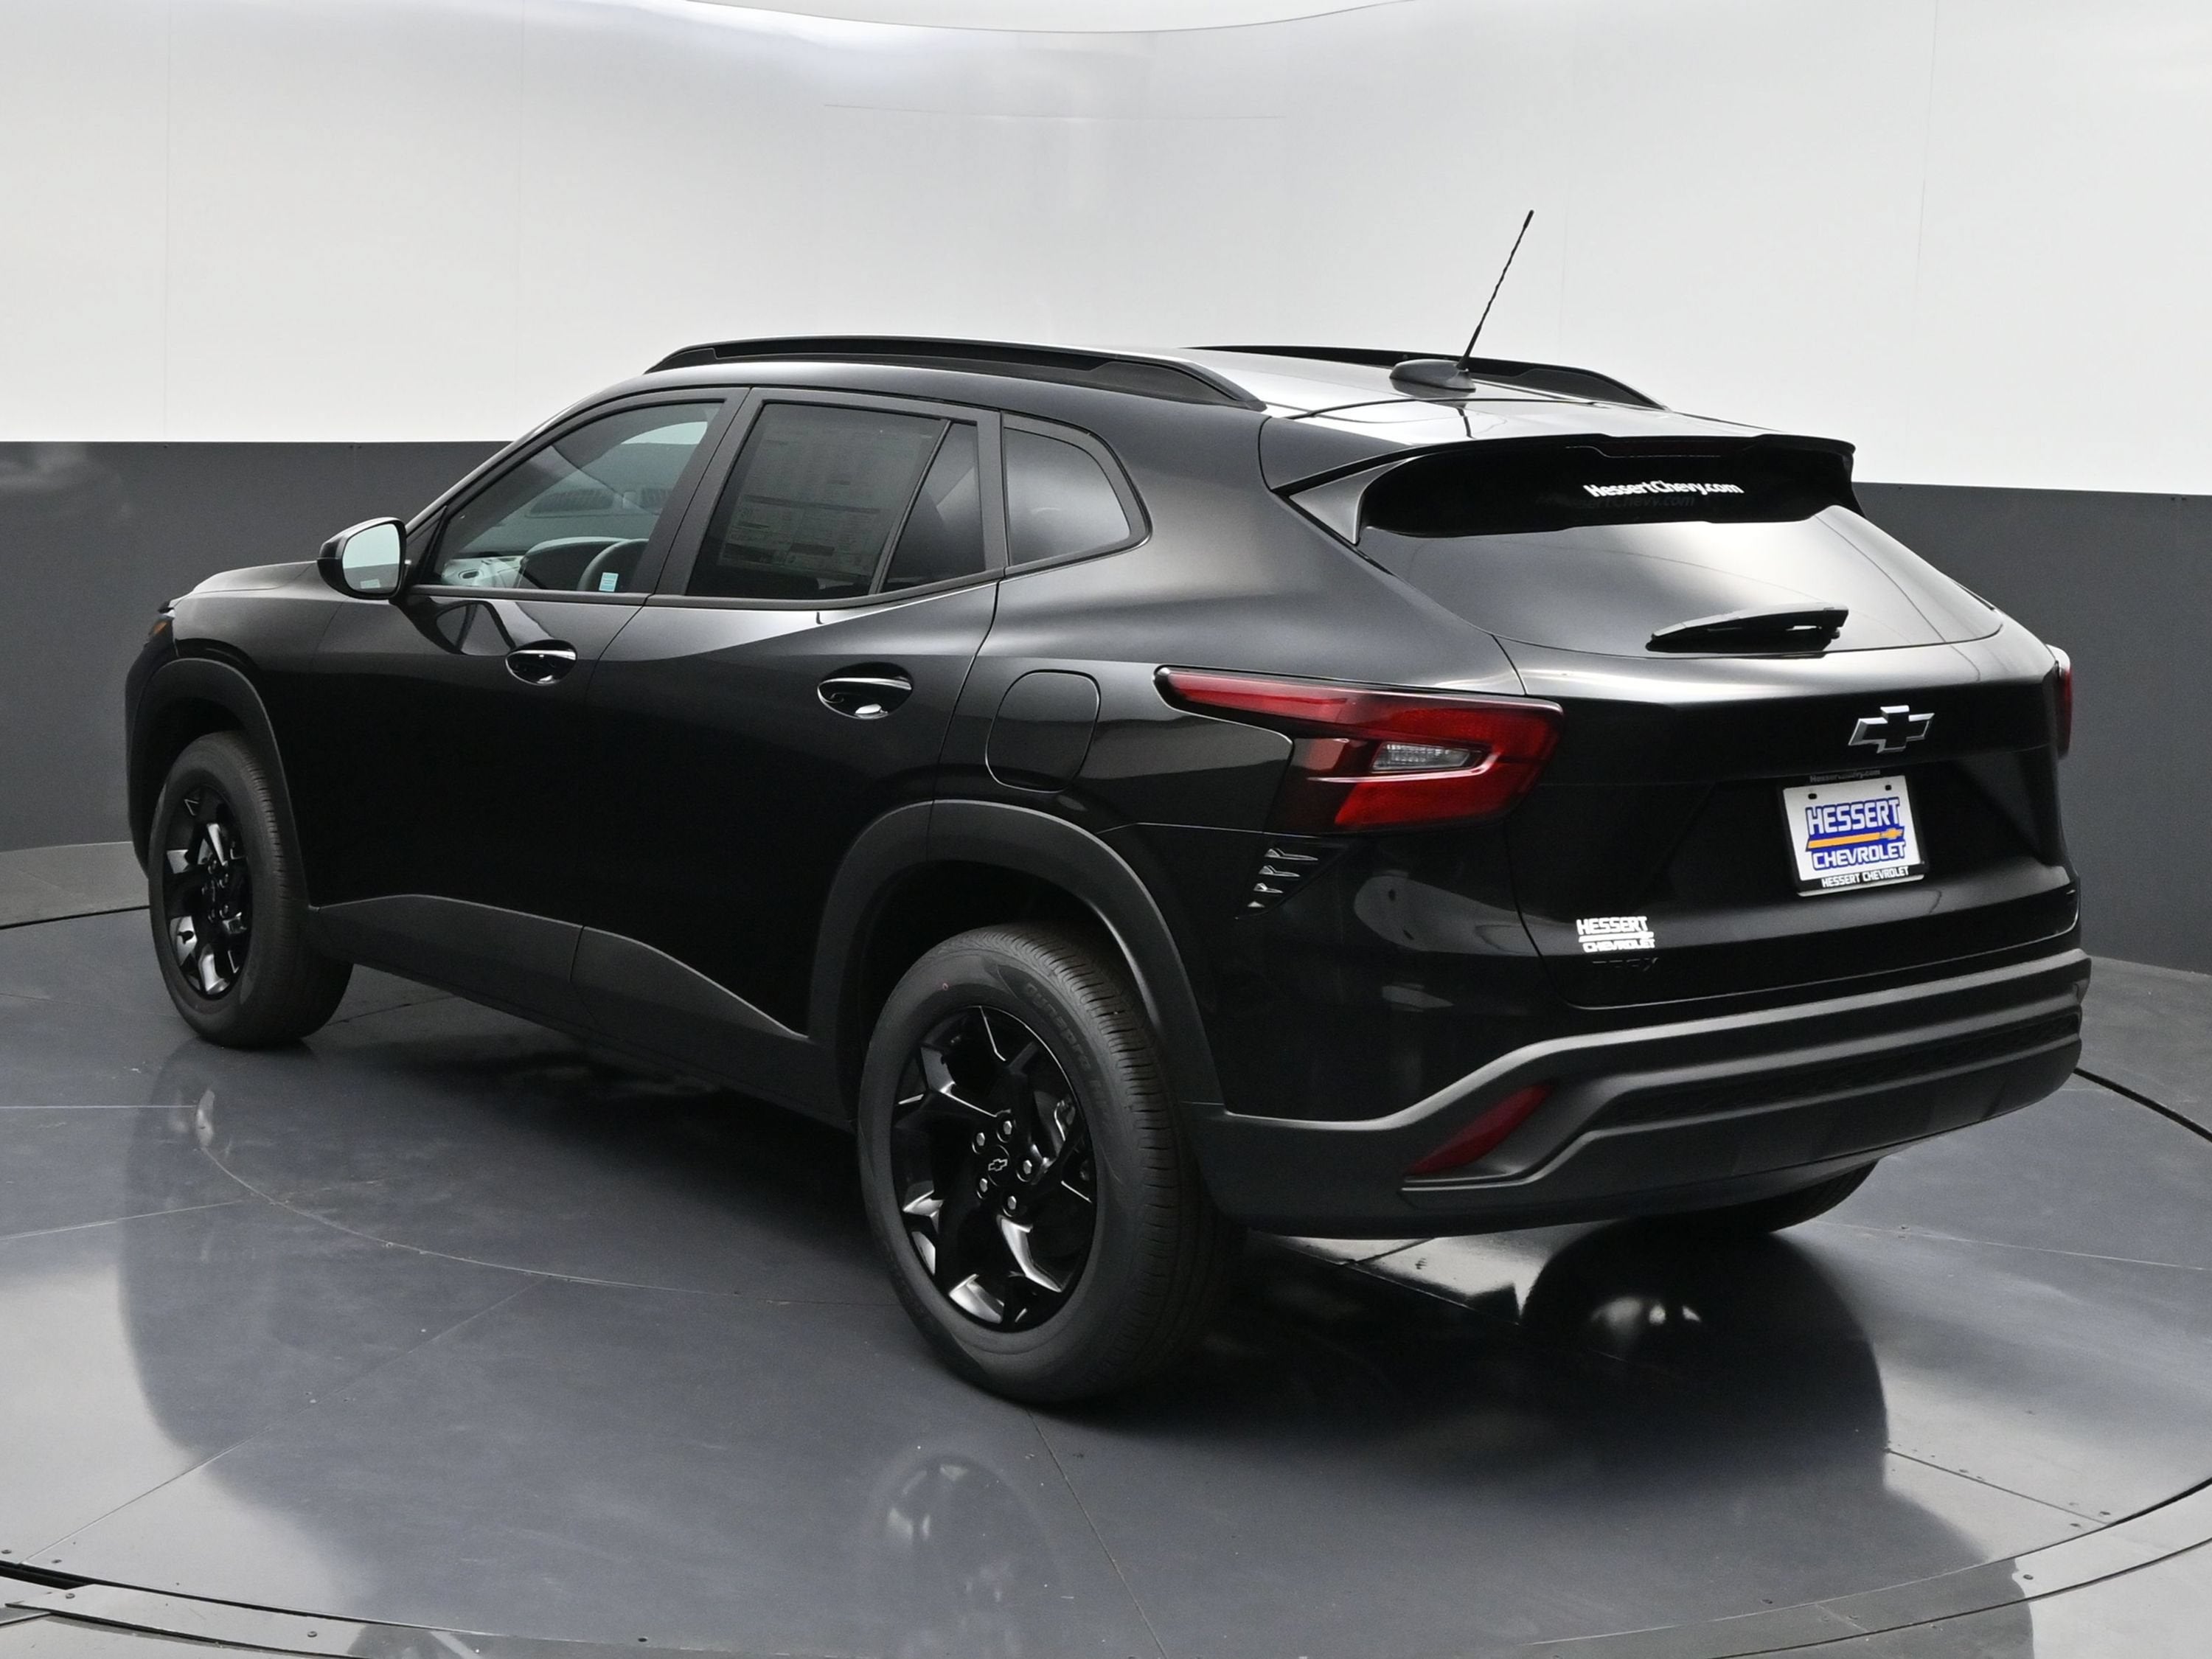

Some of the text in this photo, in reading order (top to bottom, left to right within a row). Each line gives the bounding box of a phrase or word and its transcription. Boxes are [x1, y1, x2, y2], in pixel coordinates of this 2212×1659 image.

[1583, 480, 1745, 497] HessertChevy.com
[1806, 798, 1900, 835] HESSERT
[1812, 841, 1906, 870] CHEVROLET
[1821, 866, 1909, 888] HESSERT CHEVROLET
[1576, 916, 1648, 935] HESSERT
